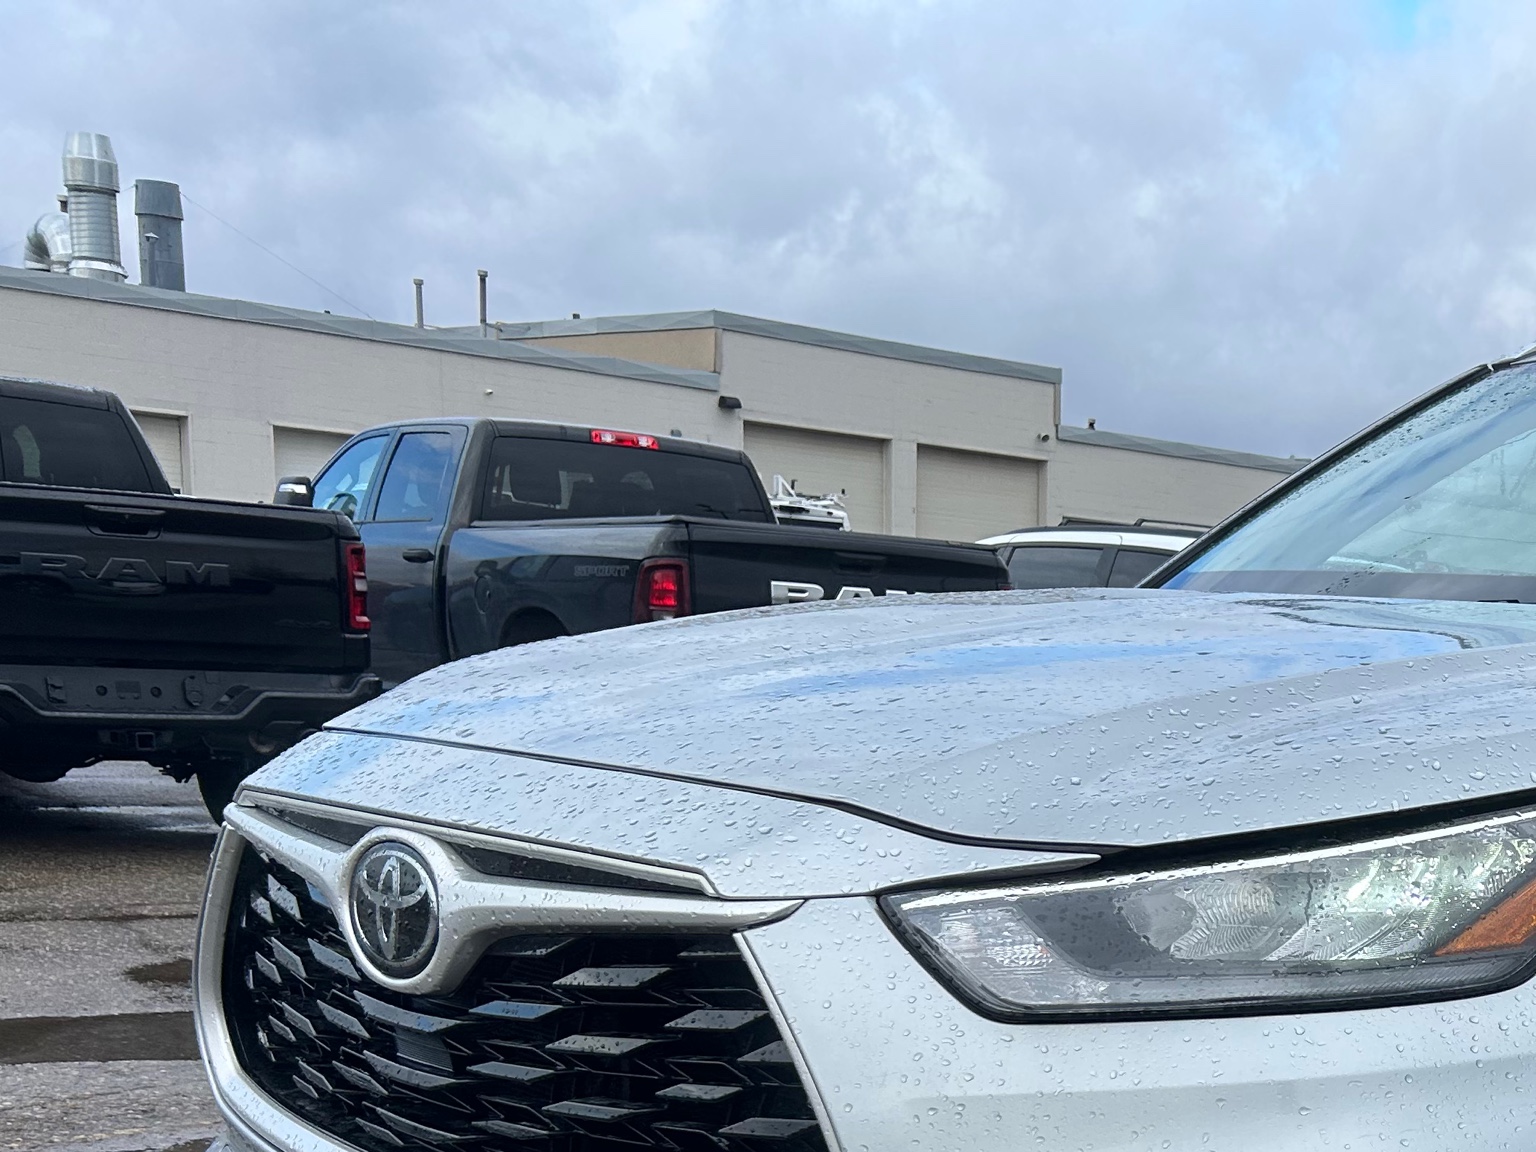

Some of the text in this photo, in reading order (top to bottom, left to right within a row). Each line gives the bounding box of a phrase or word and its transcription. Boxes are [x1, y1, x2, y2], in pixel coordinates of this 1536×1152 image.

[19, 551, 231, 588] RAM
[573, 564, 630, 577] SPORT
[770, 580, 924, 605] RA
